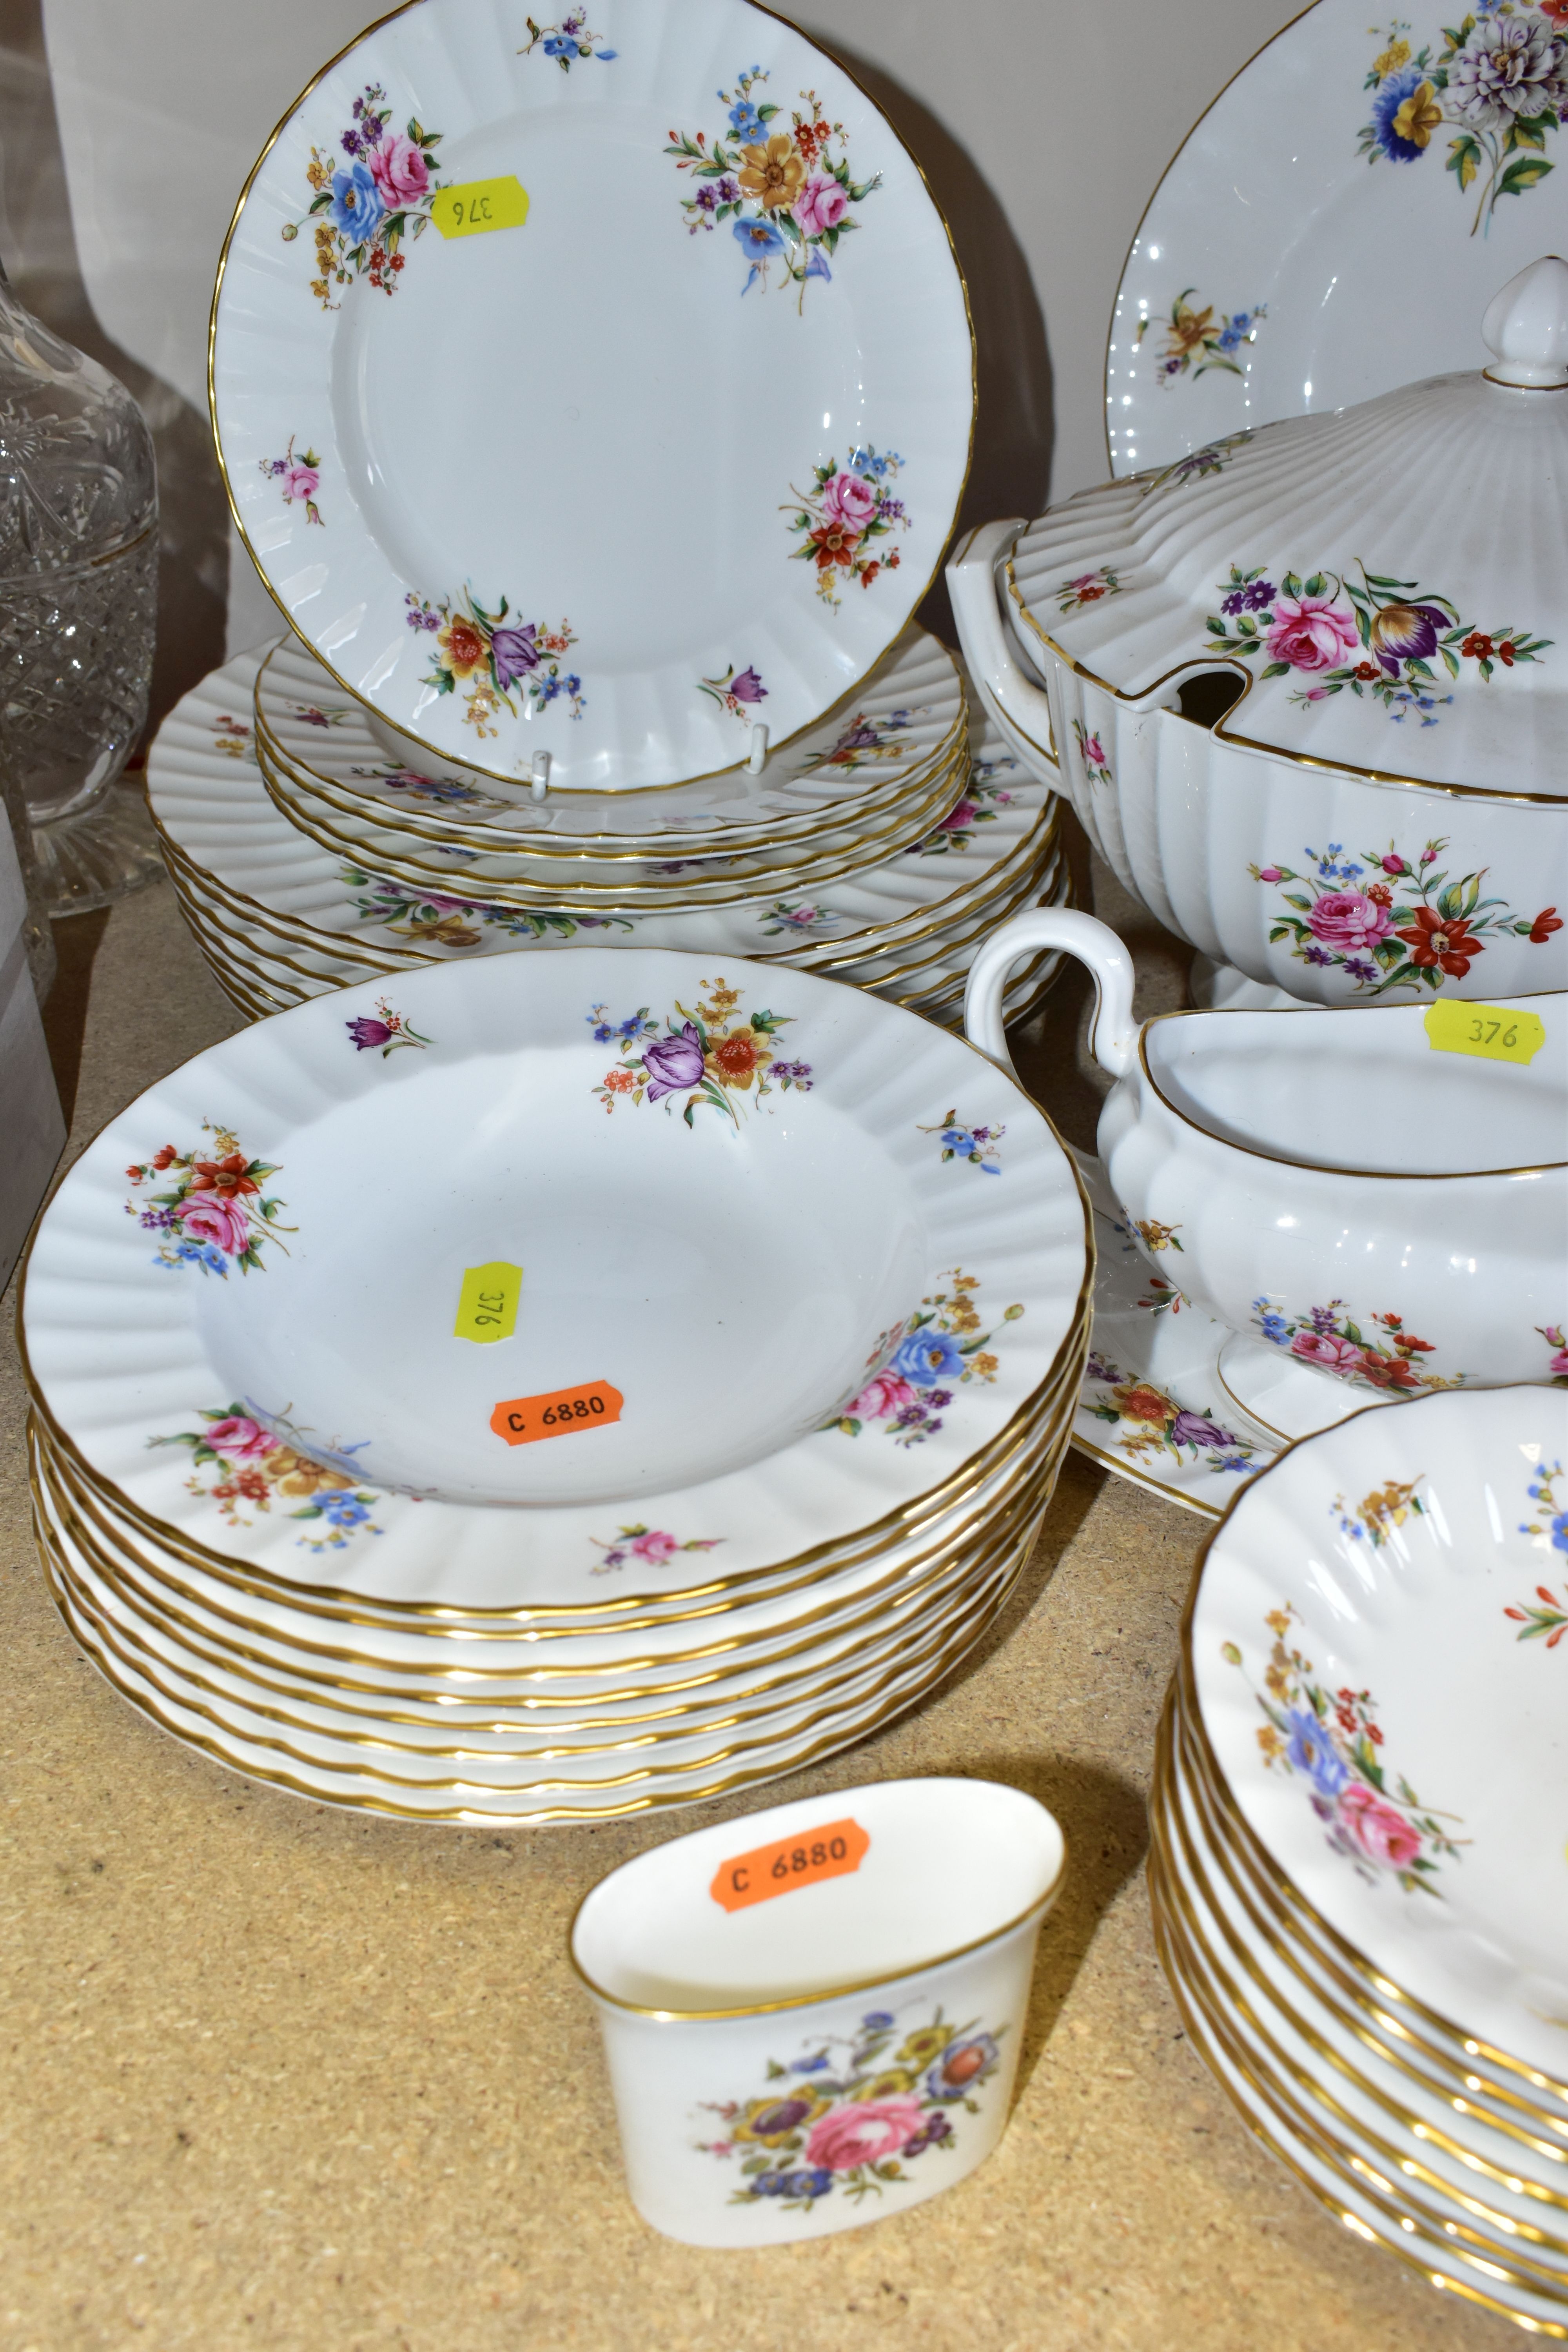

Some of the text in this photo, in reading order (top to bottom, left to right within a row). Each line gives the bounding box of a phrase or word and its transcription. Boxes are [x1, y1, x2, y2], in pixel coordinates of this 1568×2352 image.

[453, 197, 492, 226] 376
[1469, 1019, 1517, 1047] 376
[475, 1291, 505, 1325] 376
[508, 1396, 605, 1432] C 6880
[731, 1836, 847, 1893] C 6880
